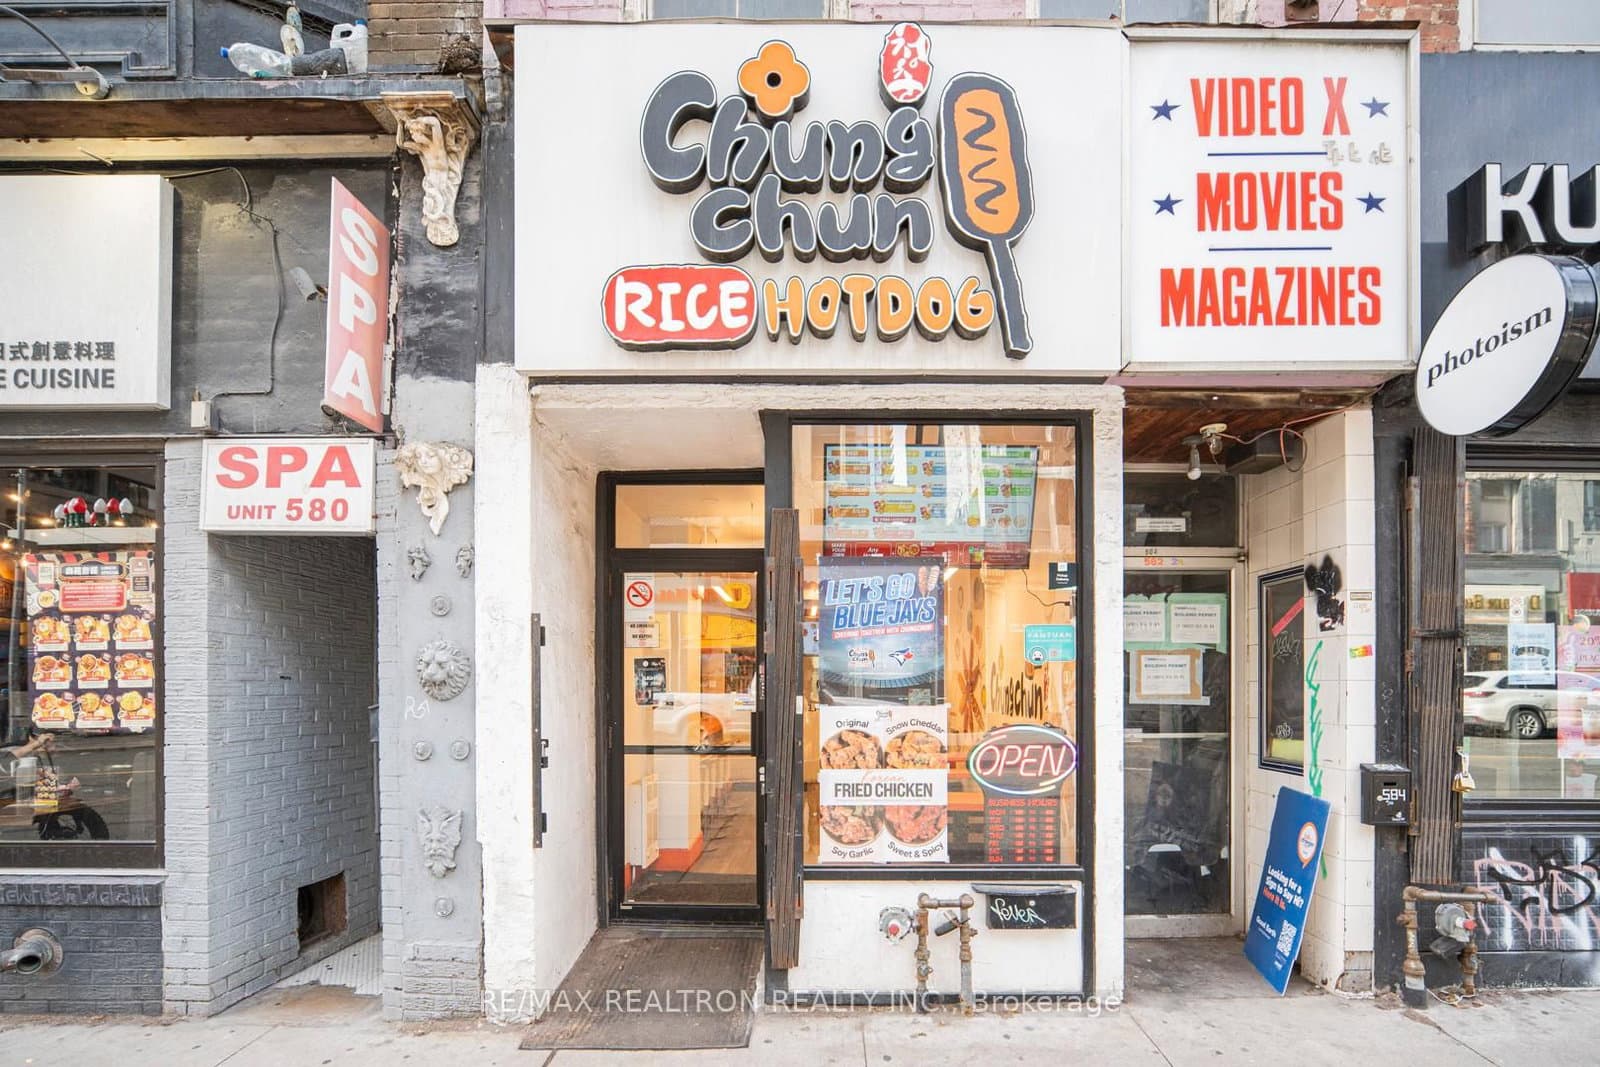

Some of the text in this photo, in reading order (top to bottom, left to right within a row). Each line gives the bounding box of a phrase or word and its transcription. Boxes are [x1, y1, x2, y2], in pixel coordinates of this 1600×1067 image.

[1190, 76, 1350, 137] VIDEO X
[640, 70, 935, 193] Chung
[1196, 171, 1344, 232] MOVIES
[1484, 162, 1600, 244] KU
[330, 207, 379, 417] SPA
[614, 273, 994, 342] RICE HOTDOG
[1160, 266, 1382, 328] MAGAZINES
[1426, 306, 1553, 388] photoism
[13, 368, 116, 389] CUISINE
[215, 445, 362, 489] SPA
[227, 498, 349, 522] UNIT 580
[825, 573, 916, 606] LET'S GO
[833, 597, 937, 630] BLUE JAYS
[836, 719, 870, 728] Original
[886, 718, 945, 735] Snow Cheddar
[976, 744, 1067, 777] OPEN
[834, 782, 933, 798] FRIED CHICKEN
[1382, 788, 1406, 801] 584
[832, 846, 874, 859] Soy Garlic
[888, 841, 913, 858] Sweet
[922, 842, 944, 857] Spicy
